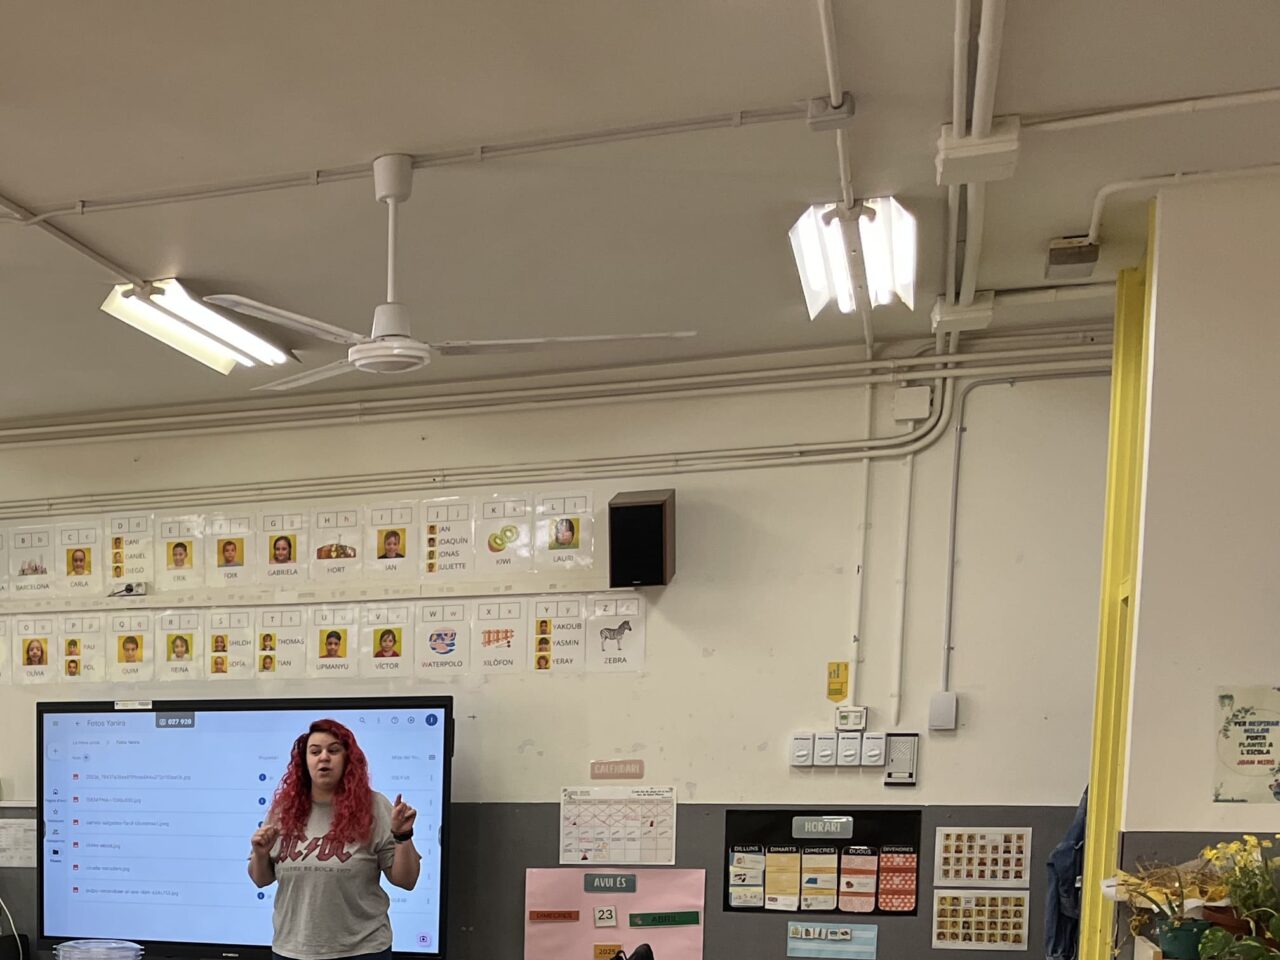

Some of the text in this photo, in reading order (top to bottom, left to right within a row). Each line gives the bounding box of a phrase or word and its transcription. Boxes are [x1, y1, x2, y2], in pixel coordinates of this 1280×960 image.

[268, 568, 298, 576] GABRIELA
[327, 566, 345, 574] HORT
[375, 662, 399, 670] VÍCTOR
[422, 660, 463, 668] WATERPOLO
[595, 764, 640, 774] CALENDARI
[805, 822, 840, 833] HORARI
[594, 876, 626, 888] AVUI ÉS
[598, 910, 613, 920] 23
